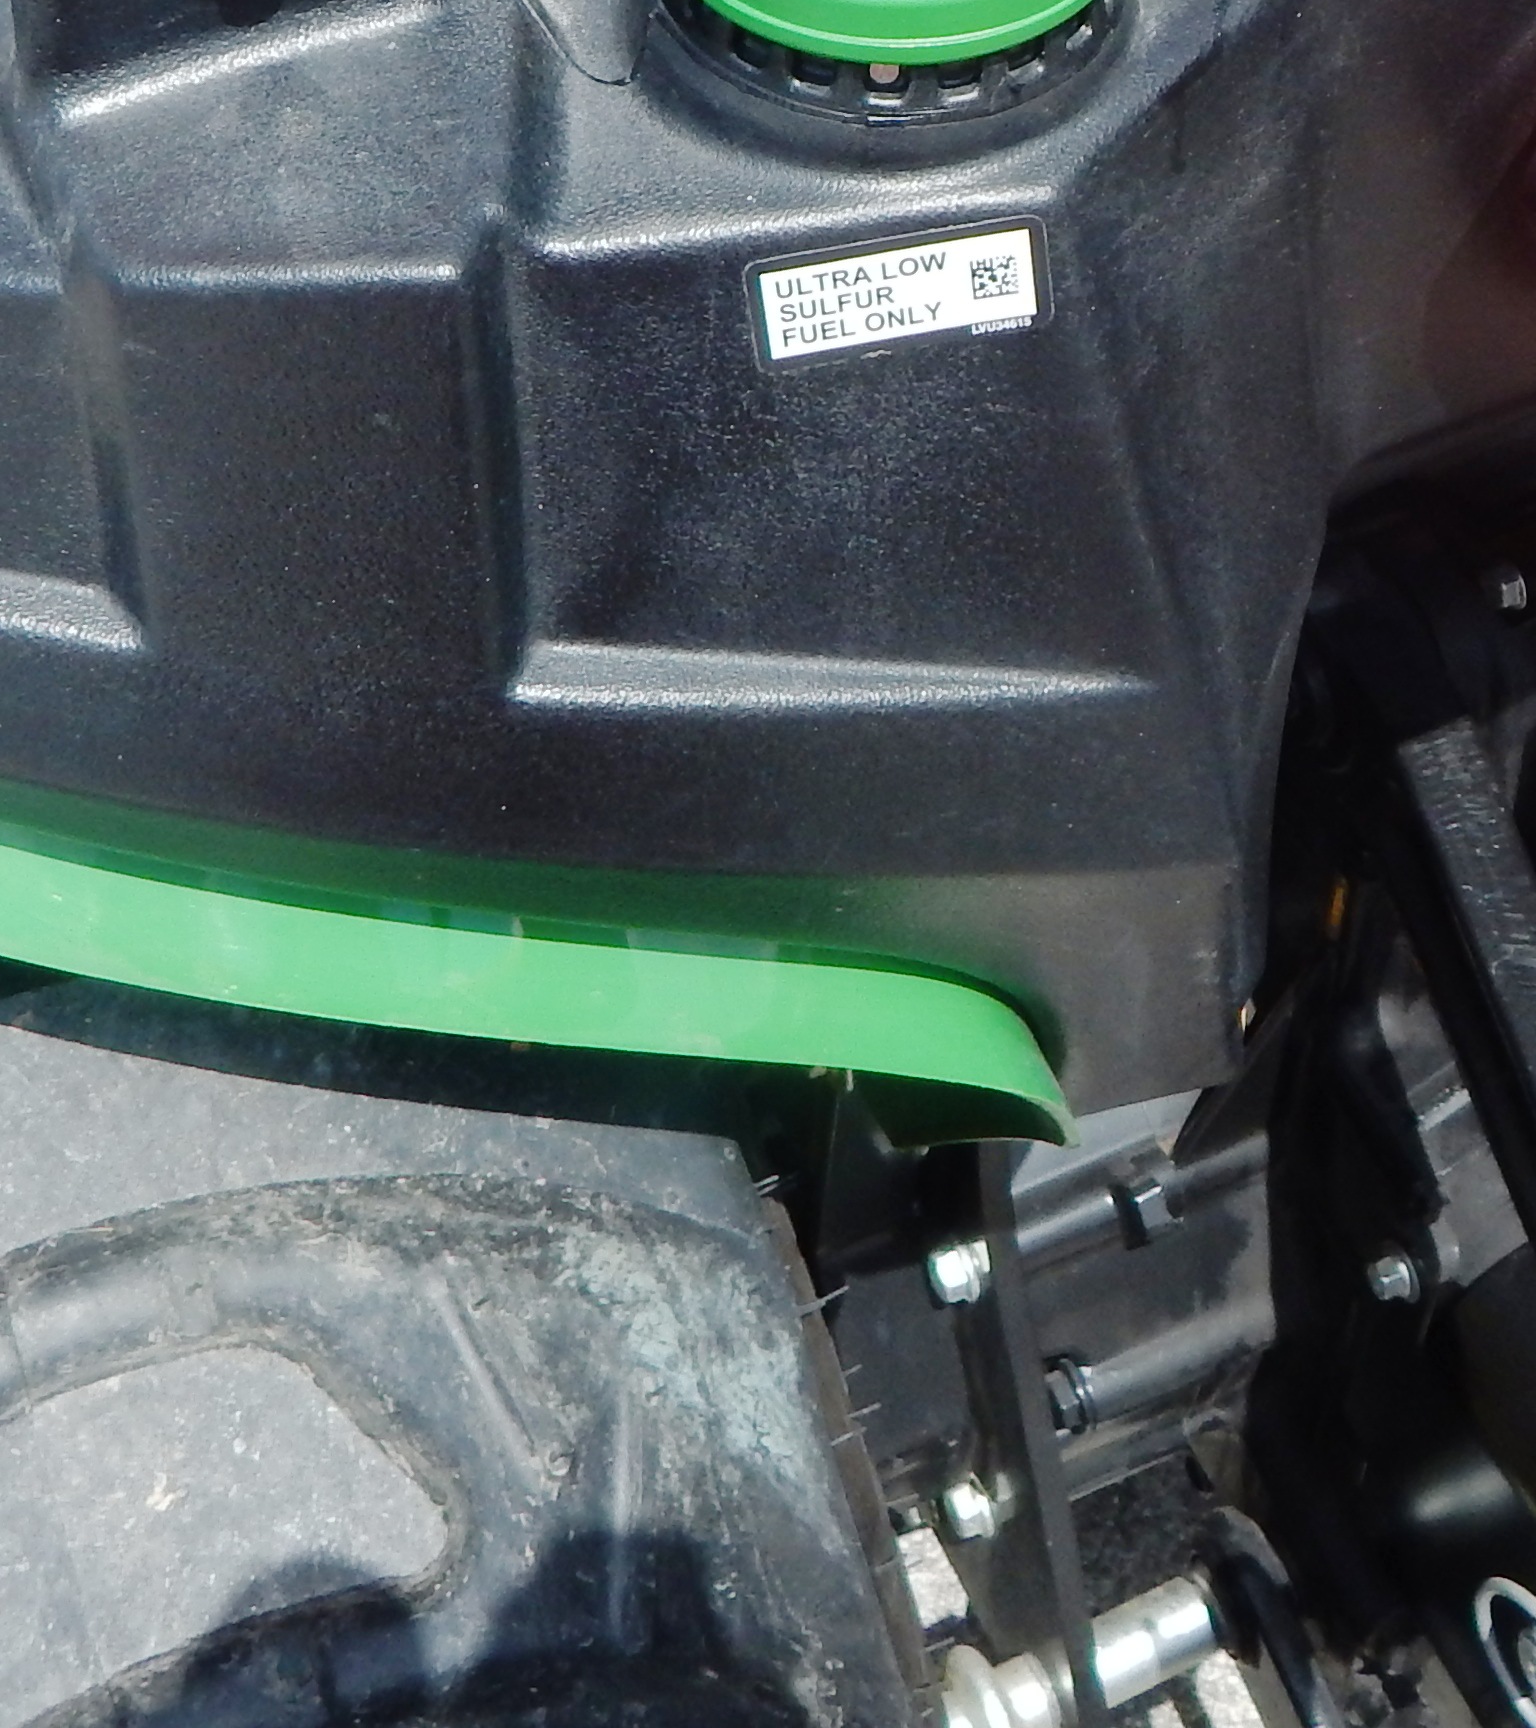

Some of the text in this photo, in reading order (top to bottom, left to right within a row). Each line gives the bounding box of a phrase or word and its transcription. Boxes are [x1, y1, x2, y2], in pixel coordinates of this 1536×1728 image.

[774, 251, 947, 299] ULTRA LOW
[779, 286, 895, 322] SULFUR
[782, 301, 942, 348] FUEL ONLY
